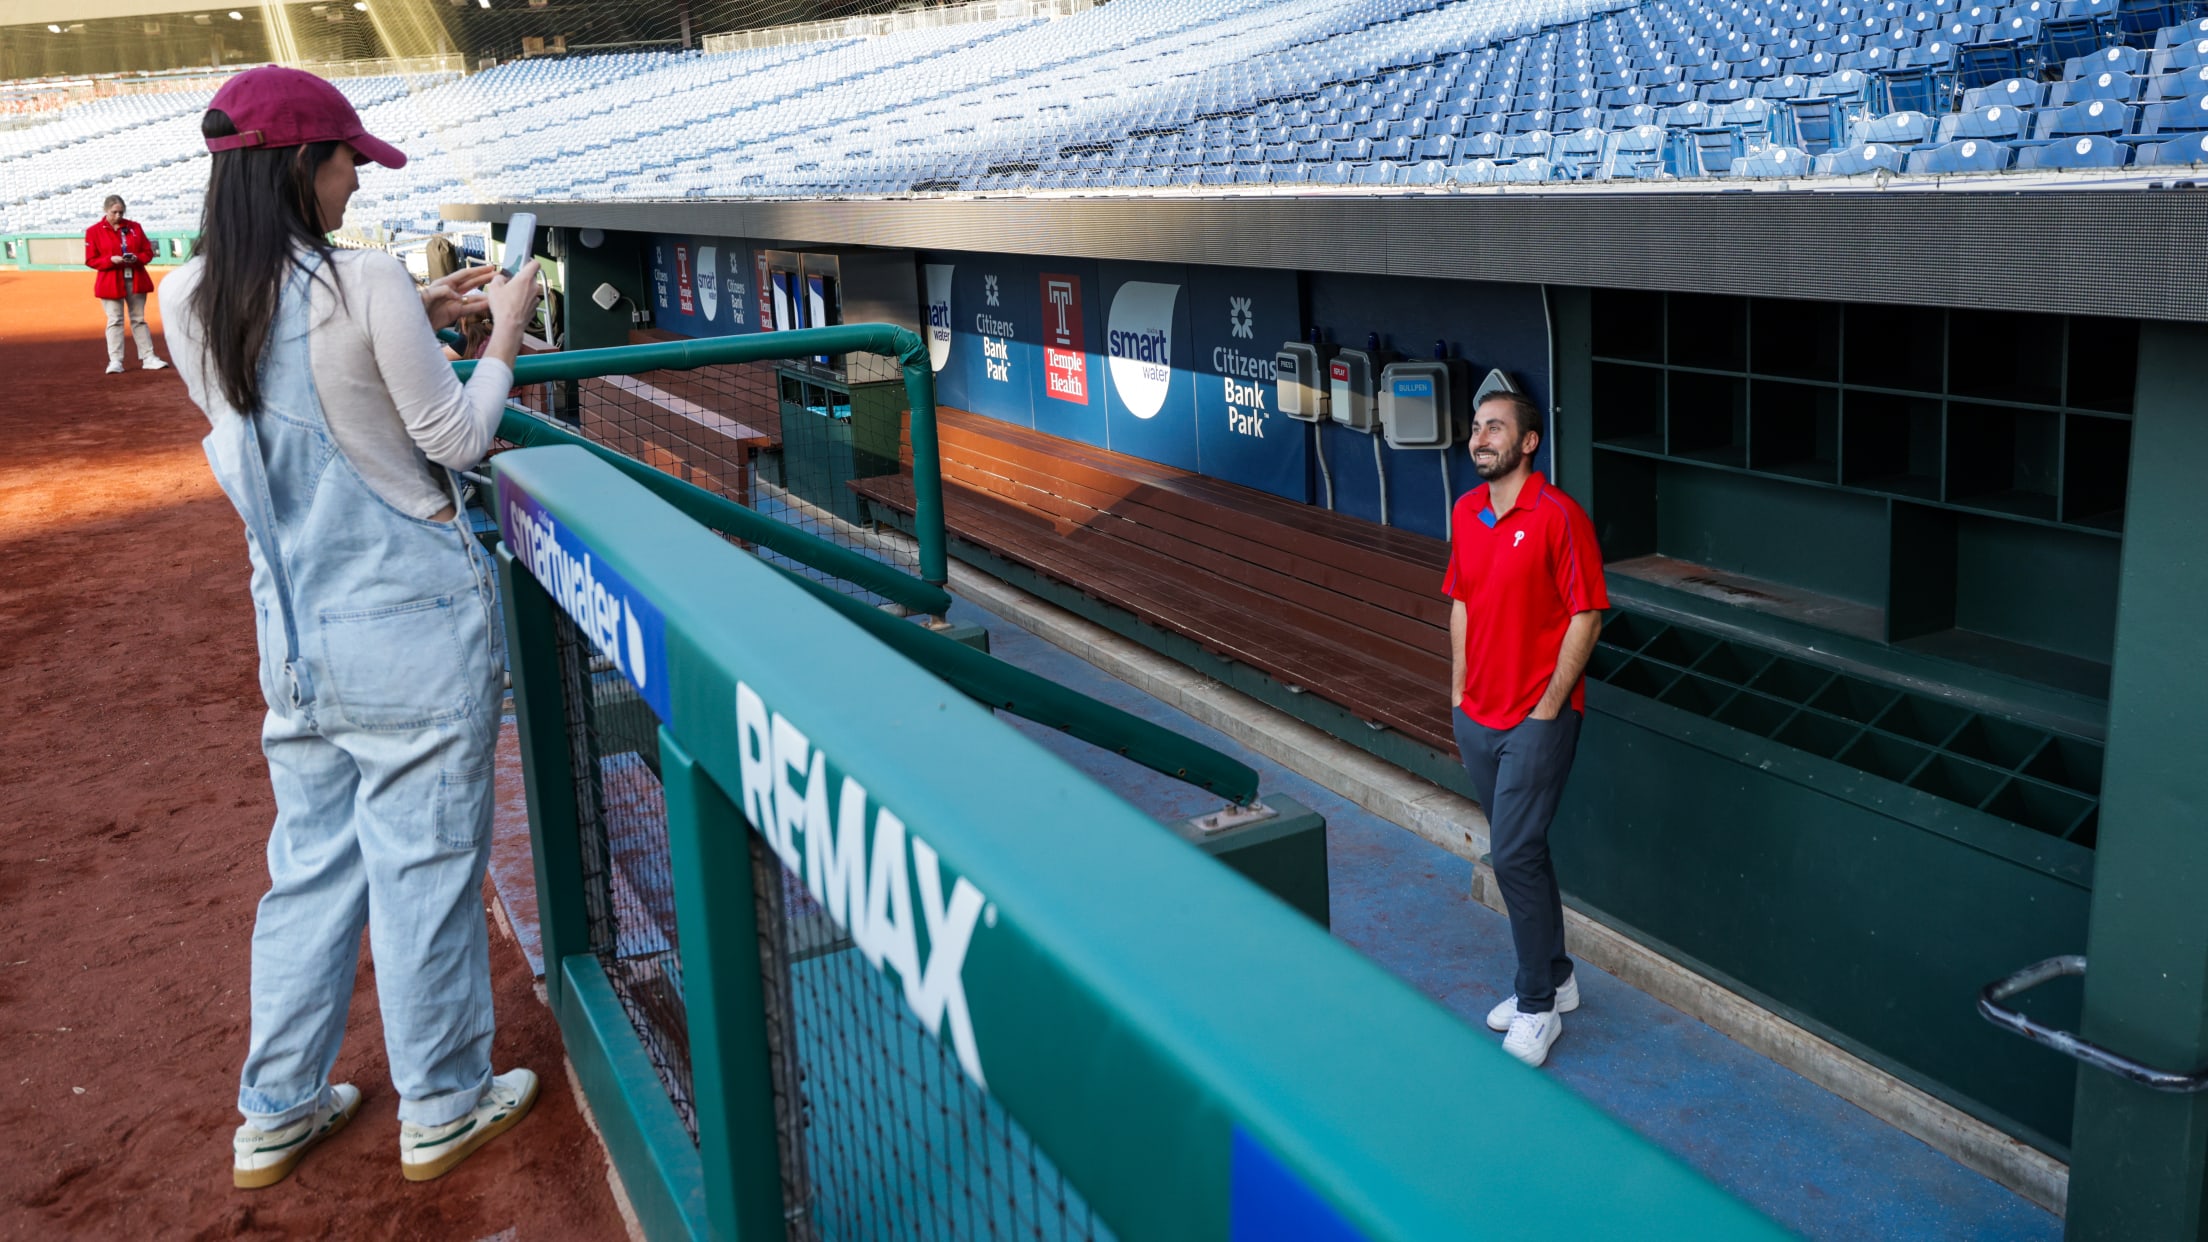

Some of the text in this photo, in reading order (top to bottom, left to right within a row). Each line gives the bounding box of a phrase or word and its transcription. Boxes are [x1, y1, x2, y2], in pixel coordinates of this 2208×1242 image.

[698, 272, 717, 291] smart
[727, 279, 745, 294] Citizens
[731, 294, 743, 309] Bank
[920, 300, 949, 328] mart
[734, 309, 744, 324] Park
[976, 313, 1014, 338] Citizens
[933, 329, 950, 342] water
[1110, 329, 1168, 365] smart
[983, 336, 1009, 361] Bank
[986, 358, 1009, 382] Park
[1047, 348, 1083, 375] Temple
[1142, 364, 1168, 382] water
[1213, 346, 1277, 381] Citizens
[1280, 360, 1294, 369] PRESS
[1050, 371, 1084, 396] Health
[1224, 376, 1265, 410] Bank
[1398, 383, 1428, 392] BULLPEN
[1228, 405, 1265, 439] Park
[1513, 530, 1525, 547] P
[510, 500, 625, 674] smartwater
[736, 680, 988, 1094] REMAX
